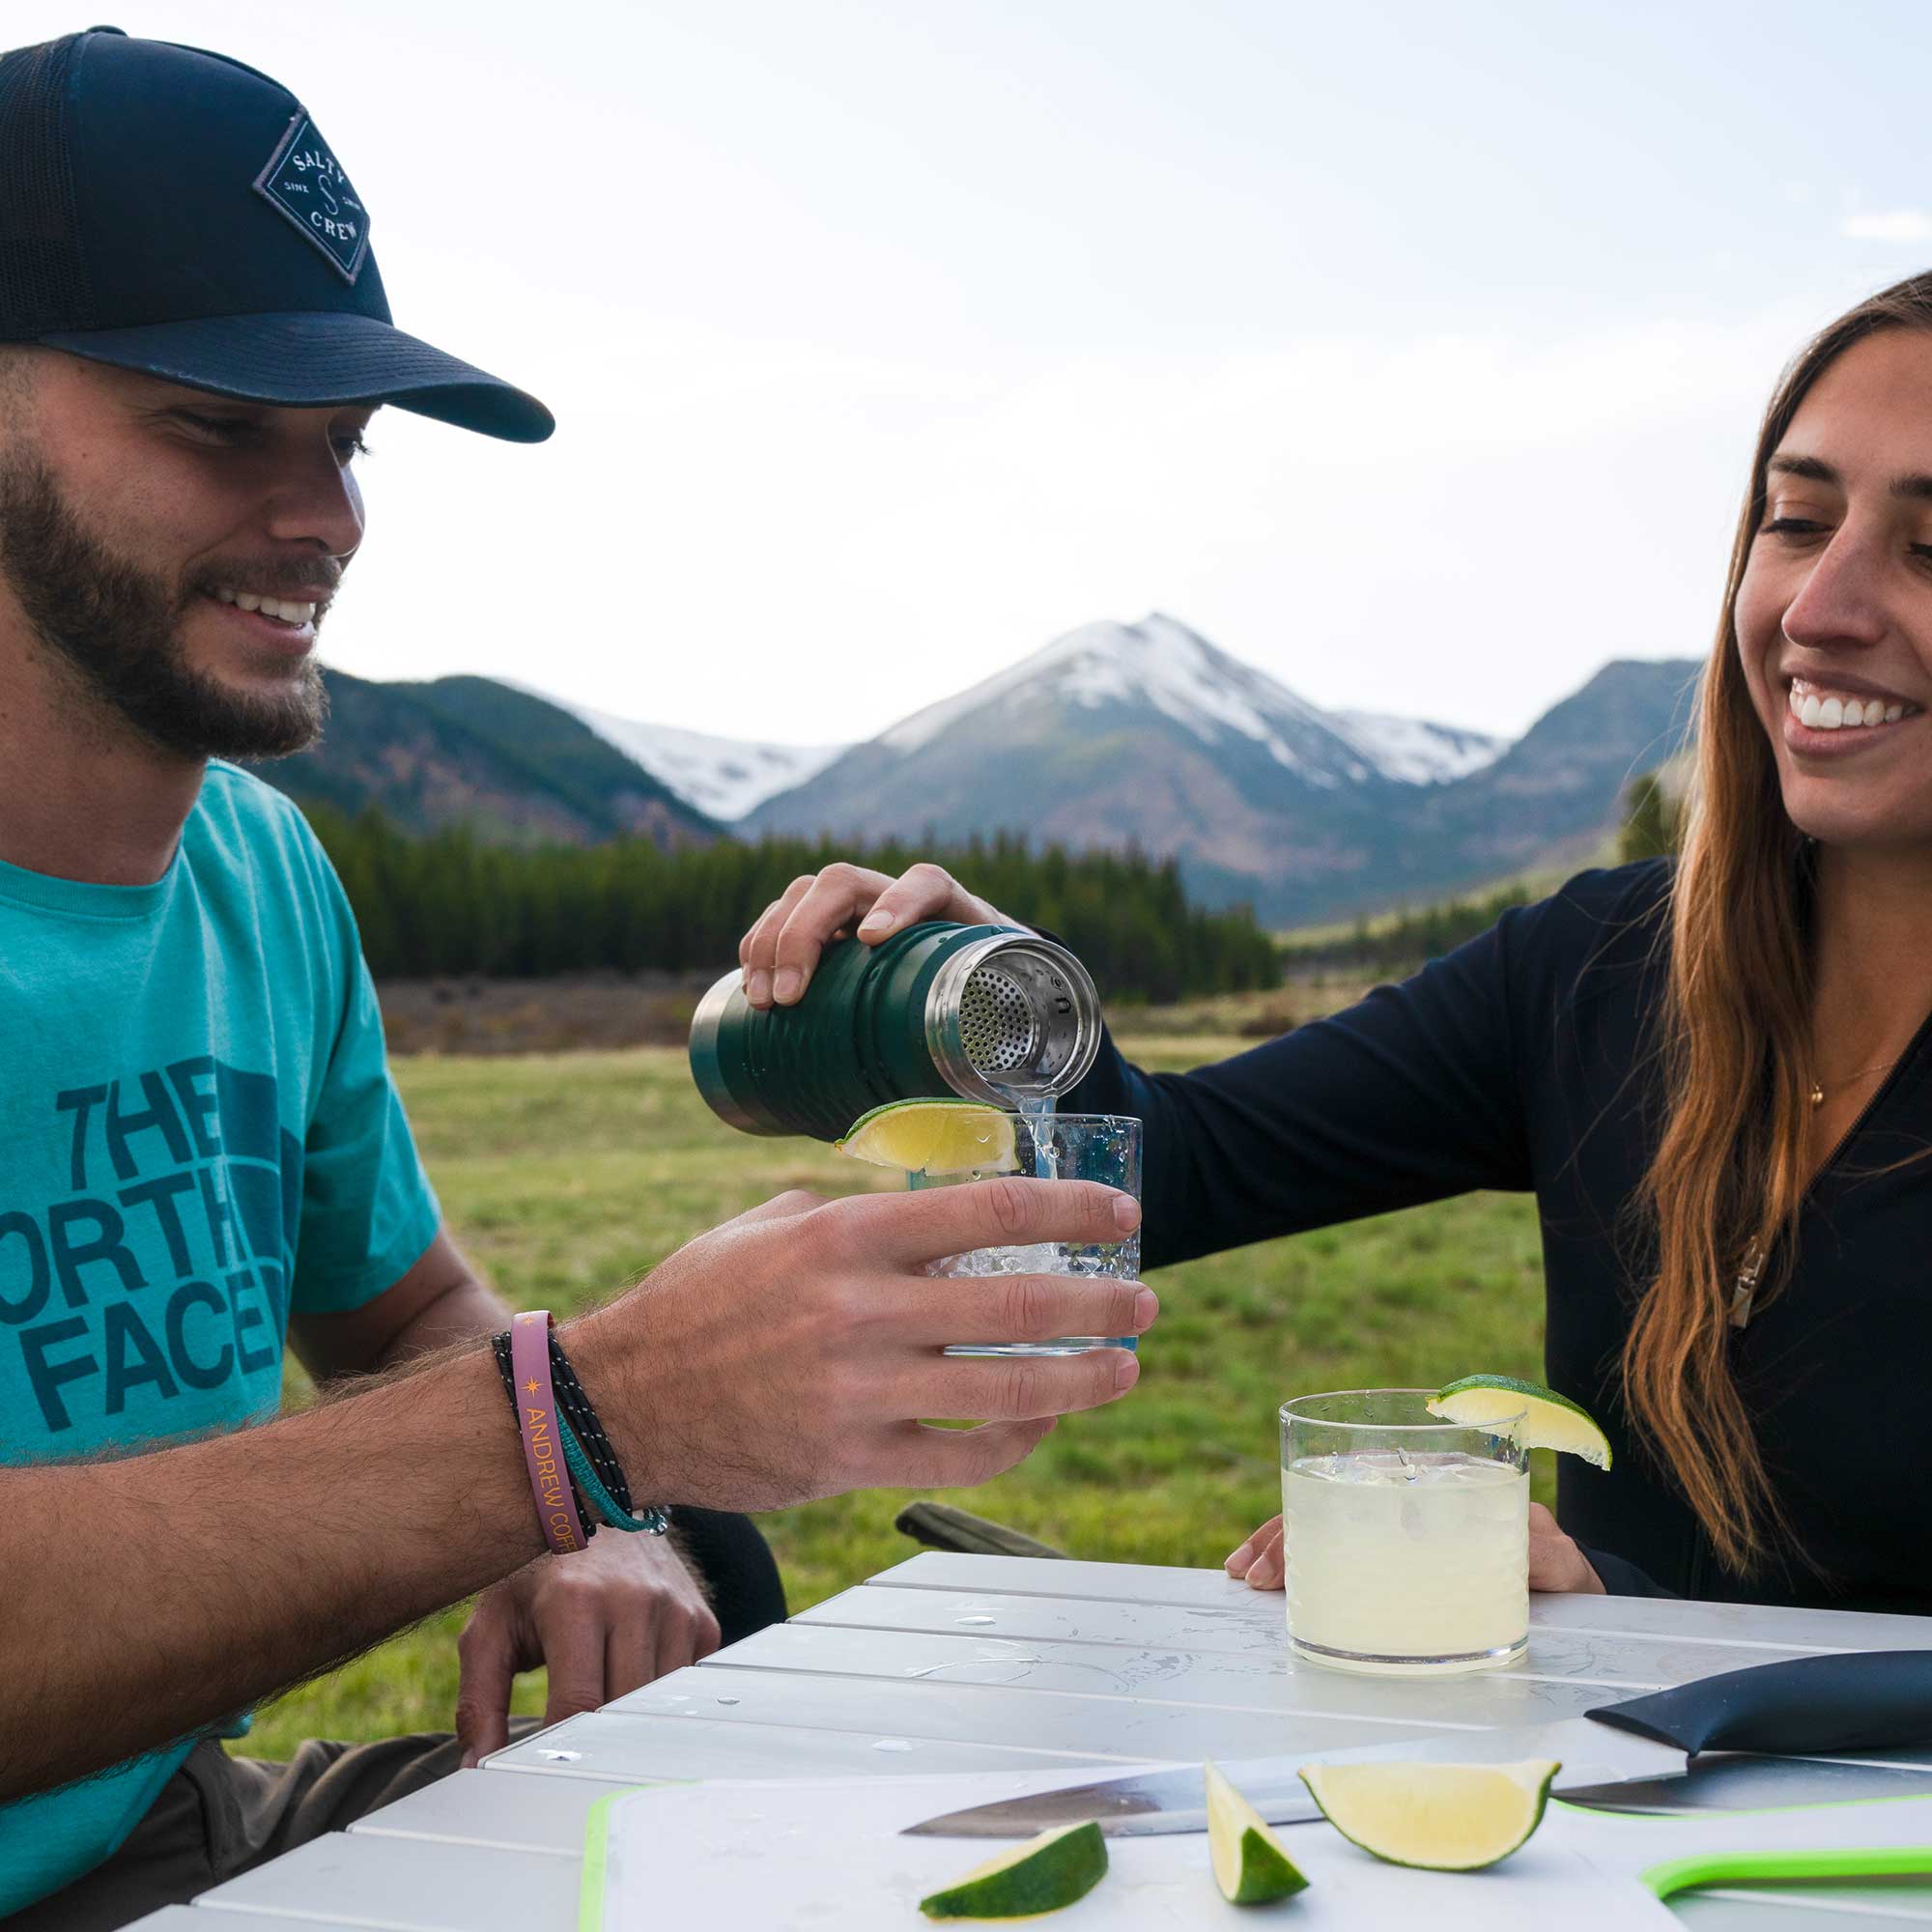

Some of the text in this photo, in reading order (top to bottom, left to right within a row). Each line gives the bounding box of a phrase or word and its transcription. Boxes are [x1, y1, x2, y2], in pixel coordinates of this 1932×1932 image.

[293, 151, 345, 184] SALTY
[310, 211, 357, 241] CREW
[56, 1055, 223, 1191] THE
[19, 1280, 274, 1433] FACE
[527, 1408, 565, 1508] ANDREW
